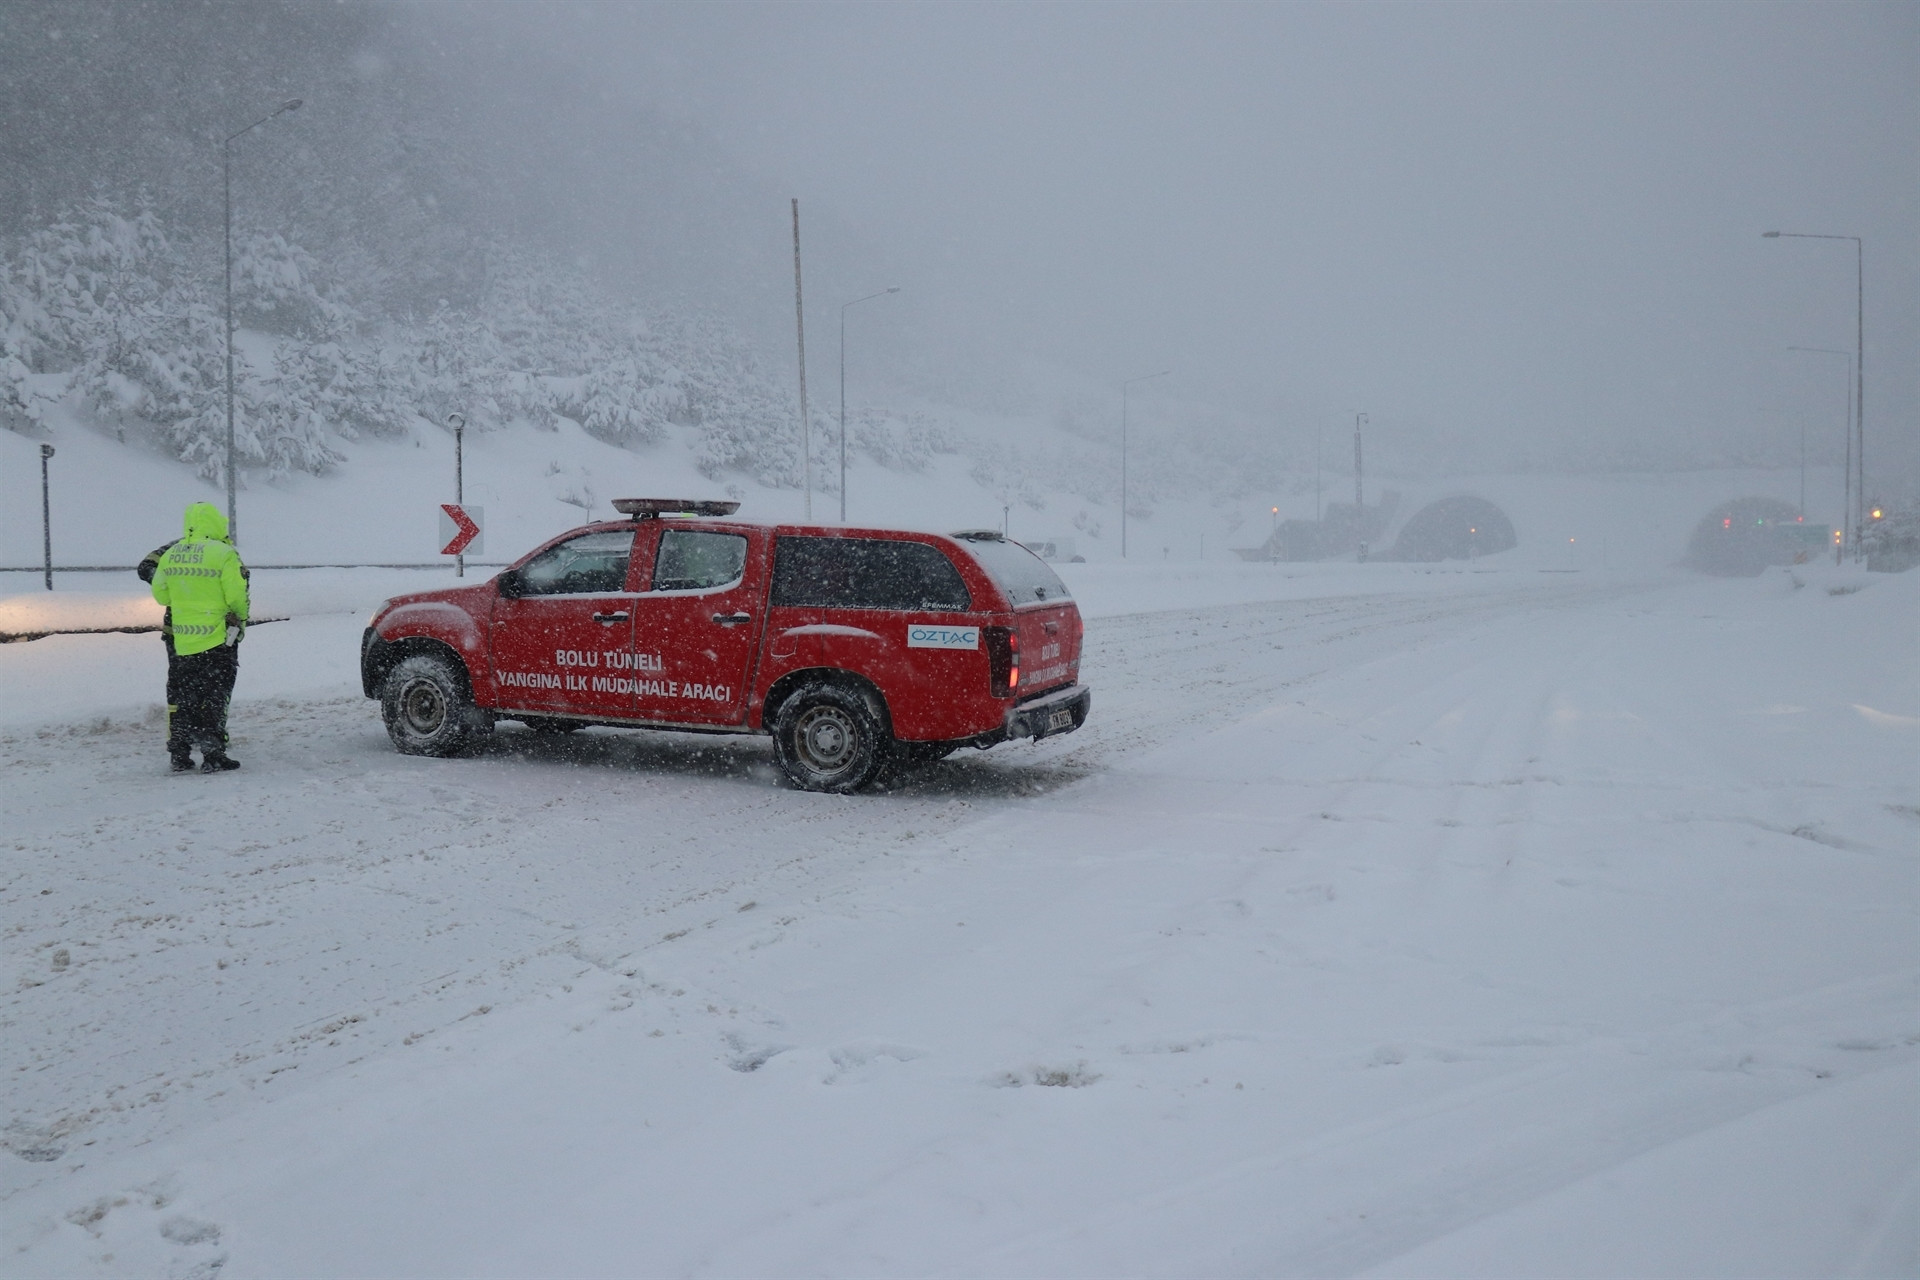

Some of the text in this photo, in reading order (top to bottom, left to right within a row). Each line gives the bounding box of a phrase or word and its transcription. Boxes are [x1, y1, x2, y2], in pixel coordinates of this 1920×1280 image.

[556, 649, 662, 671] BOLU TÜNELİ
[497, 670, 731, 702] YANGINA İLK MÜDAHALE ARACI
